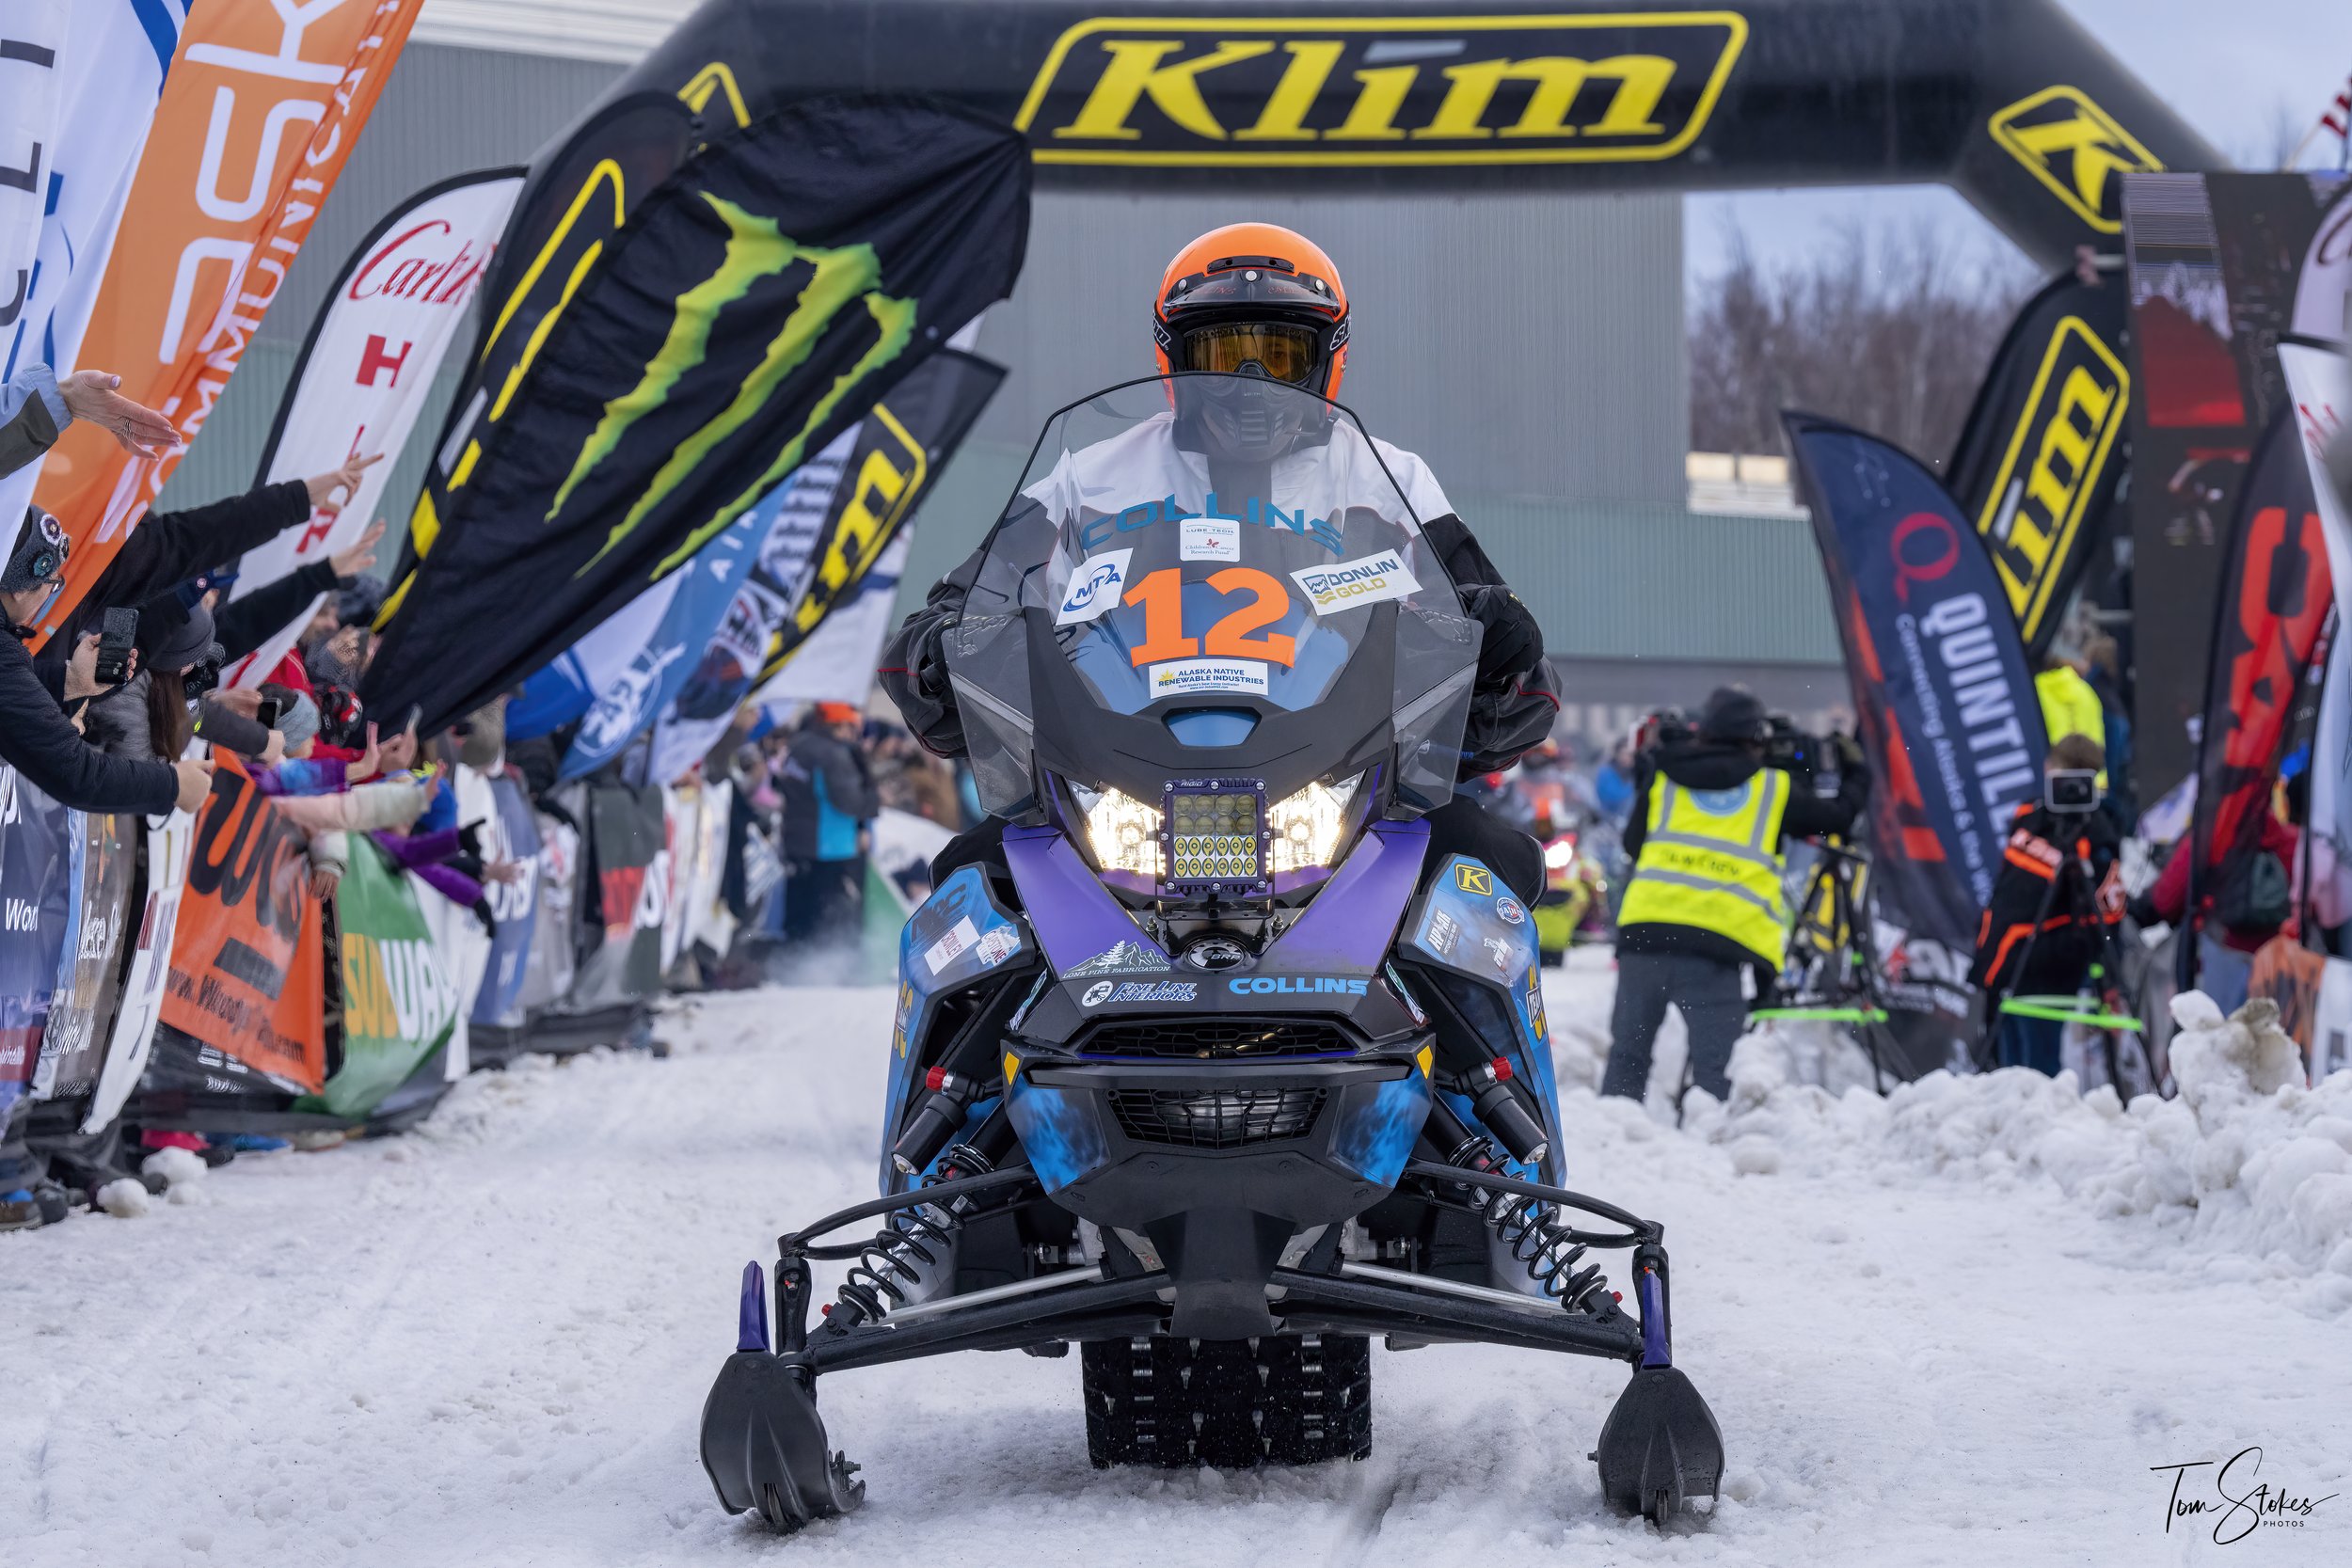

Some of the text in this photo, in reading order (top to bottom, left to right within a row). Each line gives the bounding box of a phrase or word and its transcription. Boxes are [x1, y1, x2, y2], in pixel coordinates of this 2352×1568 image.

[1052, 39, 1677, 140] Klim
[1082, 492, 1345, 557] COLLINS
[1327, 559, 1399, 586] DONLIN
[1075, 572, 1121, 599] MTA
[1335, 577, 1387, 598] GOLD
[1122, 567, 1295, 670] 12
[1158, 675, 1263, 687] RENEWABLE INDUSTRIES
[1461, 868, 1487, 892] K
[1063, 971, 1088, 979] LONE
[1107, 990, 1198, 1003] INTERIORS
[1156, 980, 1198, 993] LINE
[1229, 977, 1370, 997] COLLINS
